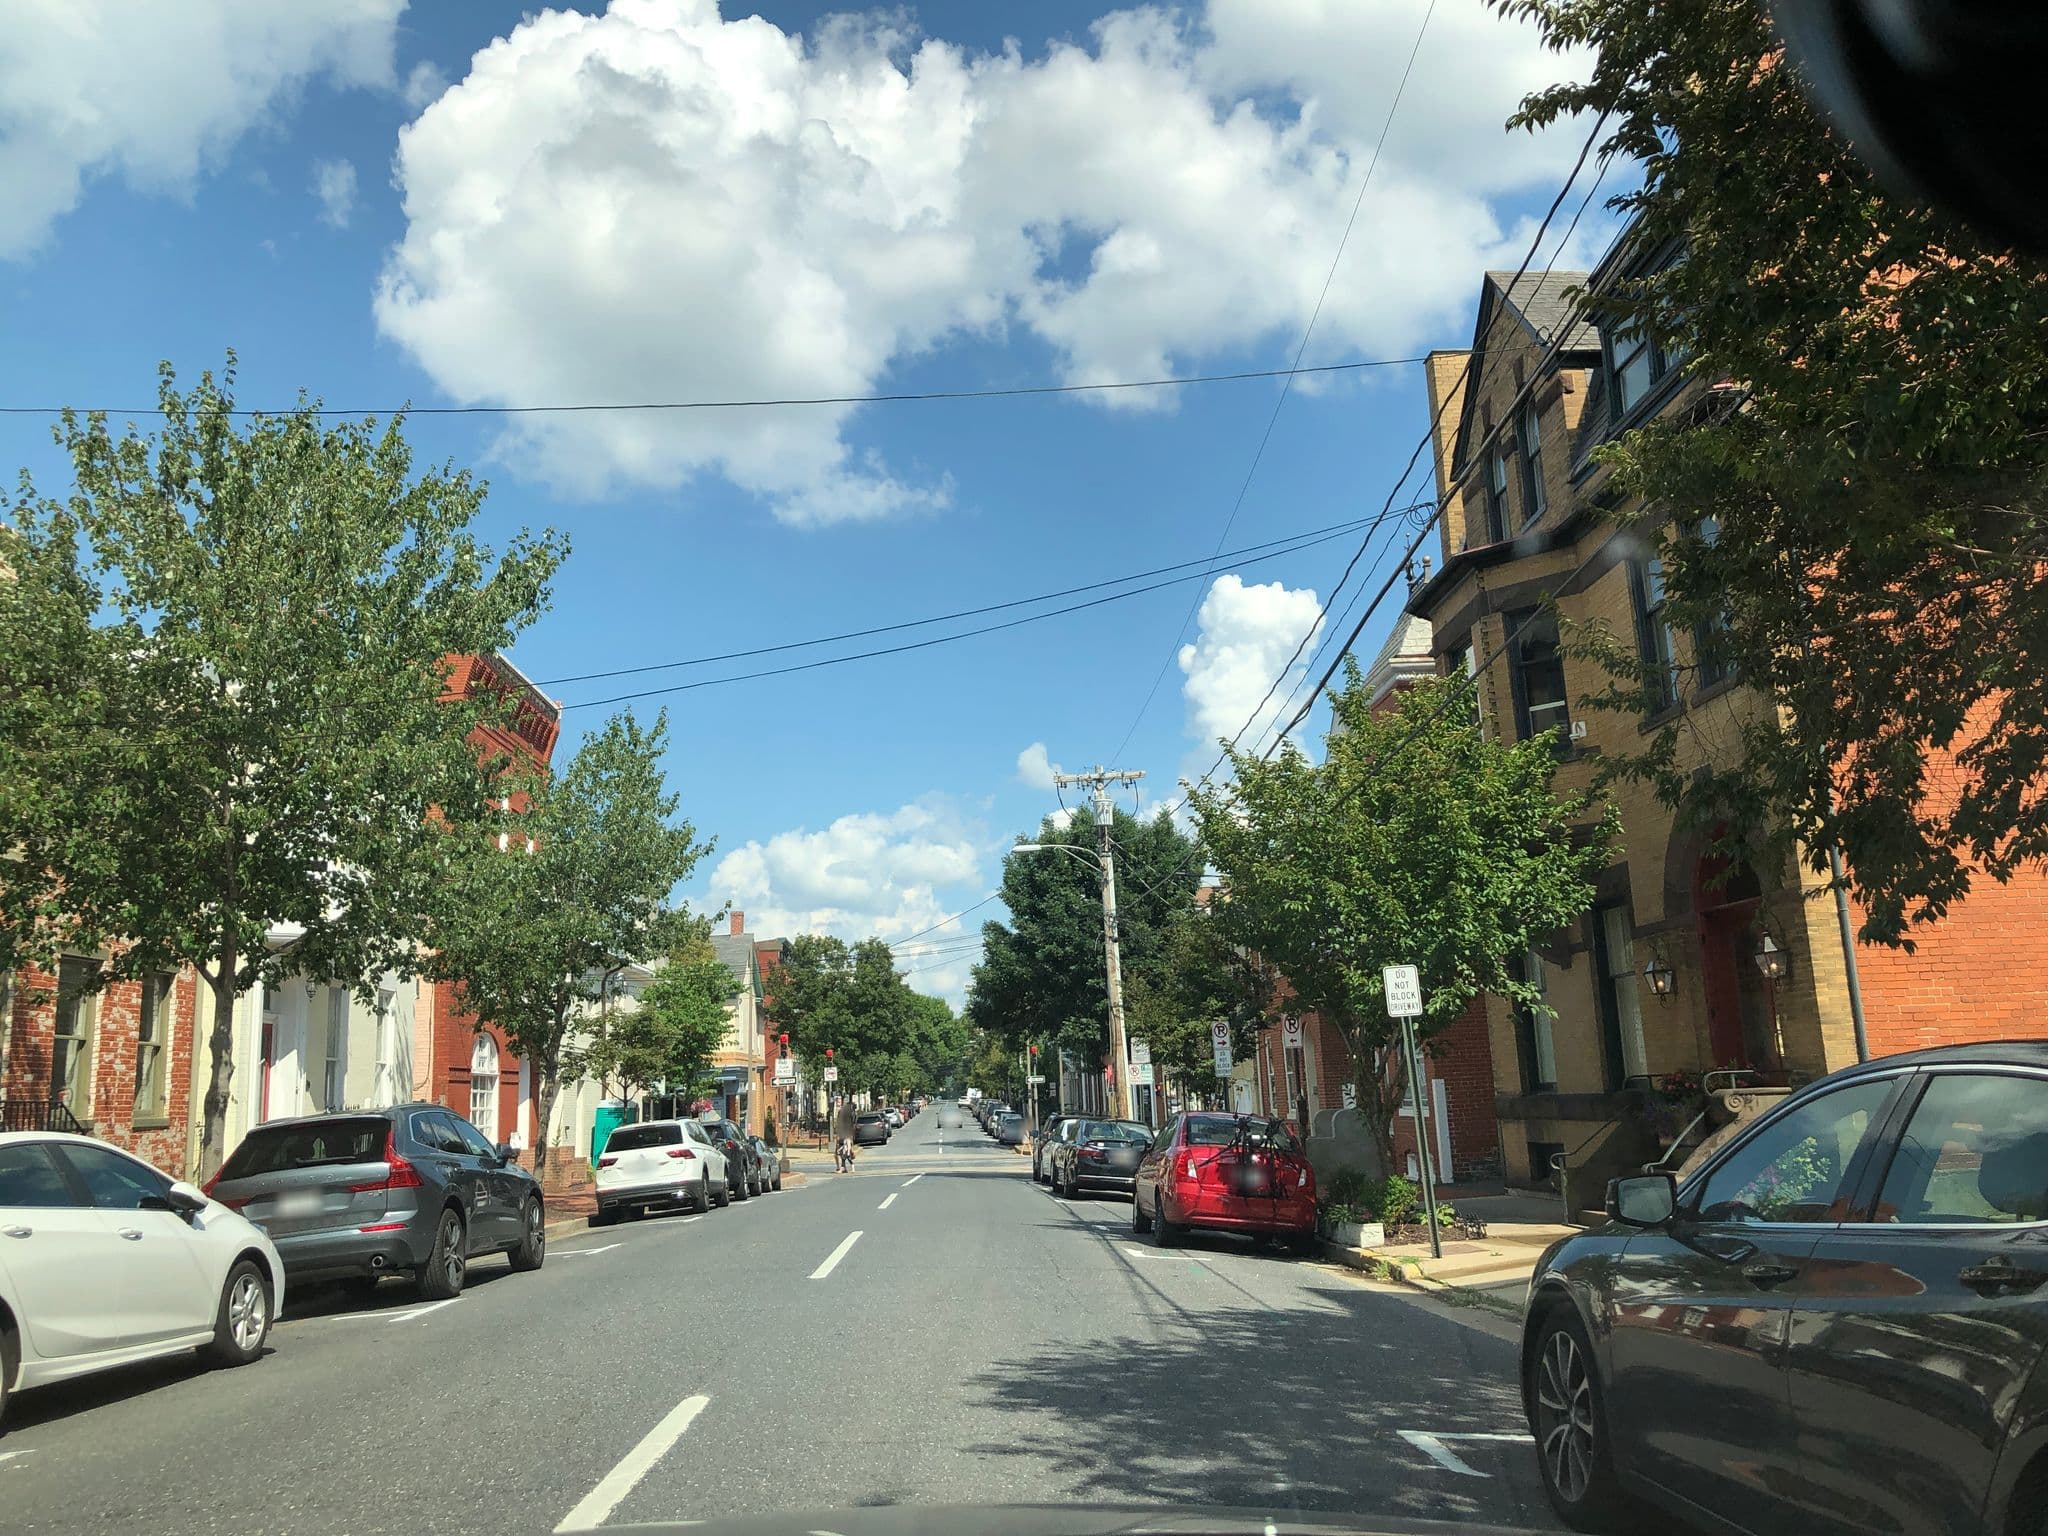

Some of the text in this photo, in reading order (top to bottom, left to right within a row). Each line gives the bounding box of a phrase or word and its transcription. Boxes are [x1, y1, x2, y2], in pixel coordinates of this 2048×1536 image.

[1395, 970, 1406, 979] DO
[1394, 981, 1409, 989] NOT
[1391, 992, 1416, 1000] BLOCK
[1391, 1002, 1419, 1011] DRIVEWAY
